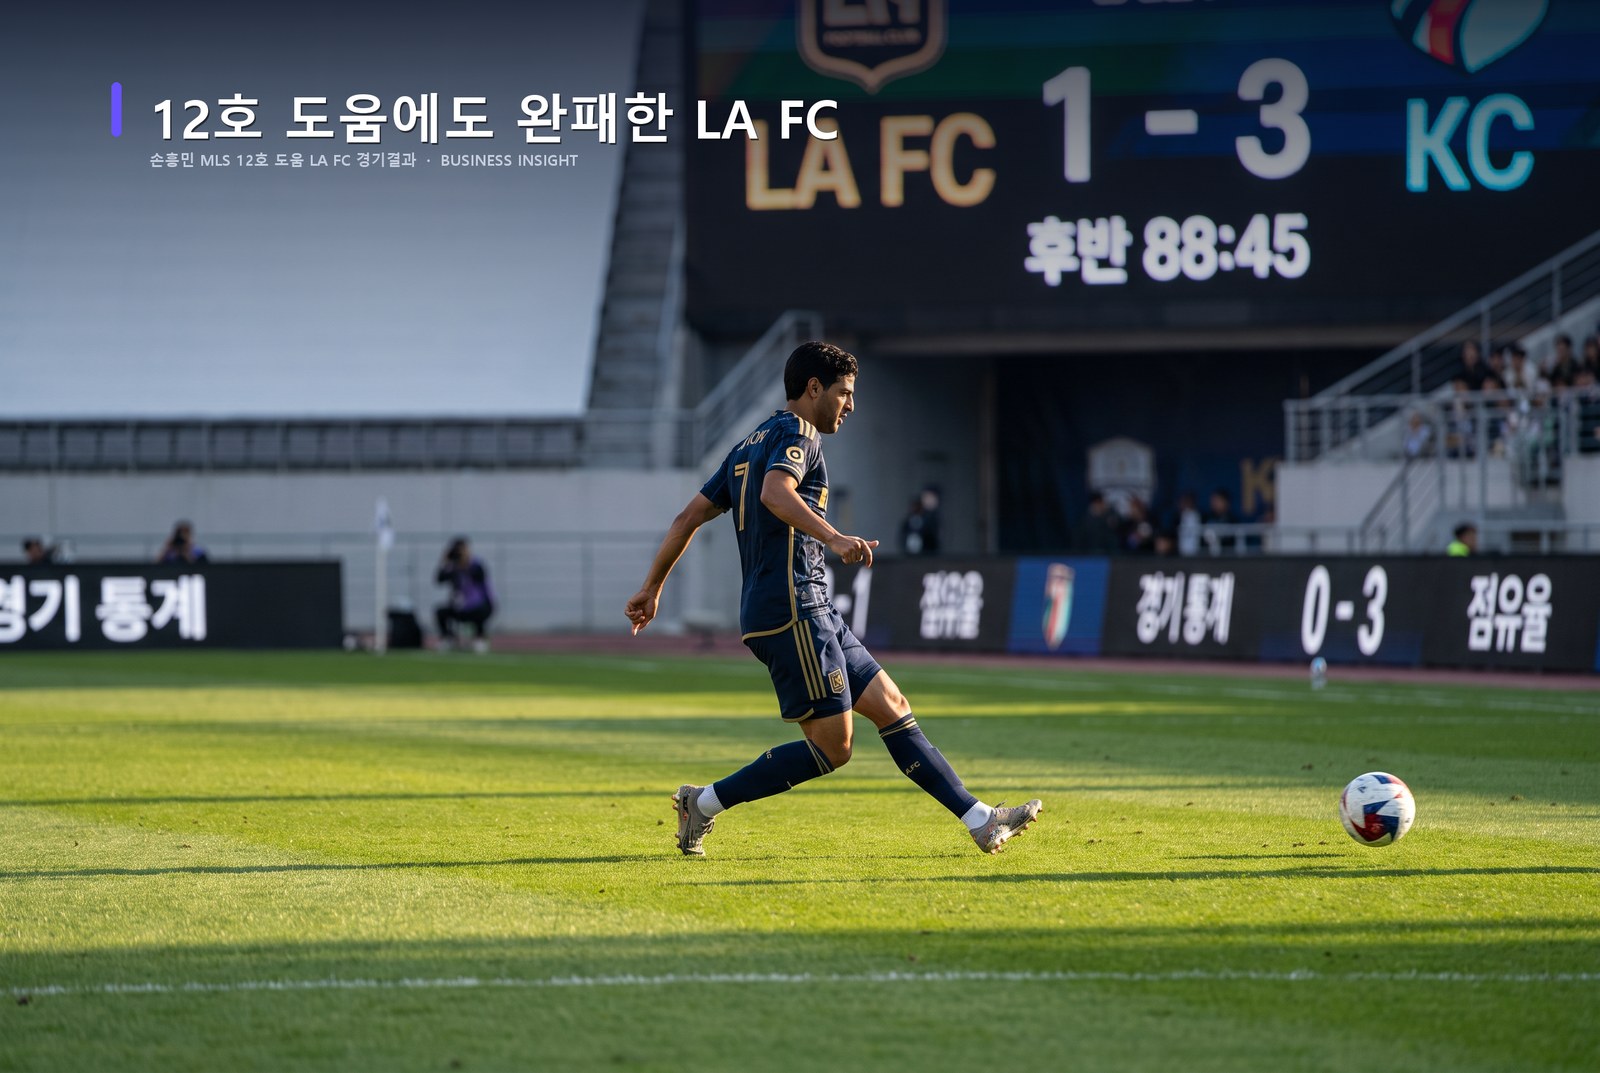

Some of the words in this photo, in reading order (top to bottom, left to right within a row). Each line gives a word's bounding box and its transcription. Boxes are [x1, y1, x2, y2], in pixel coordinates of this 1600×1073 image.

[1043, 67, 1091, 183] 1
[1235, 58, 1311, 179] 3
[1405, 93, 1535, 192] KC
[745, 118, 862, 211] LA
[880, 112, 997, 208] FC
[1024, 215, 1133, 286] 후반
[1142, 213, 1311, 282] 88:45
[734, 461, 750, 532] 7
[95, 574, 207, 642] 통계
[1136, 571, 1186, 645] 경기
[1182, 572, 1236, 646] 통계
[1466, 571, 1554, 653] 점유율
